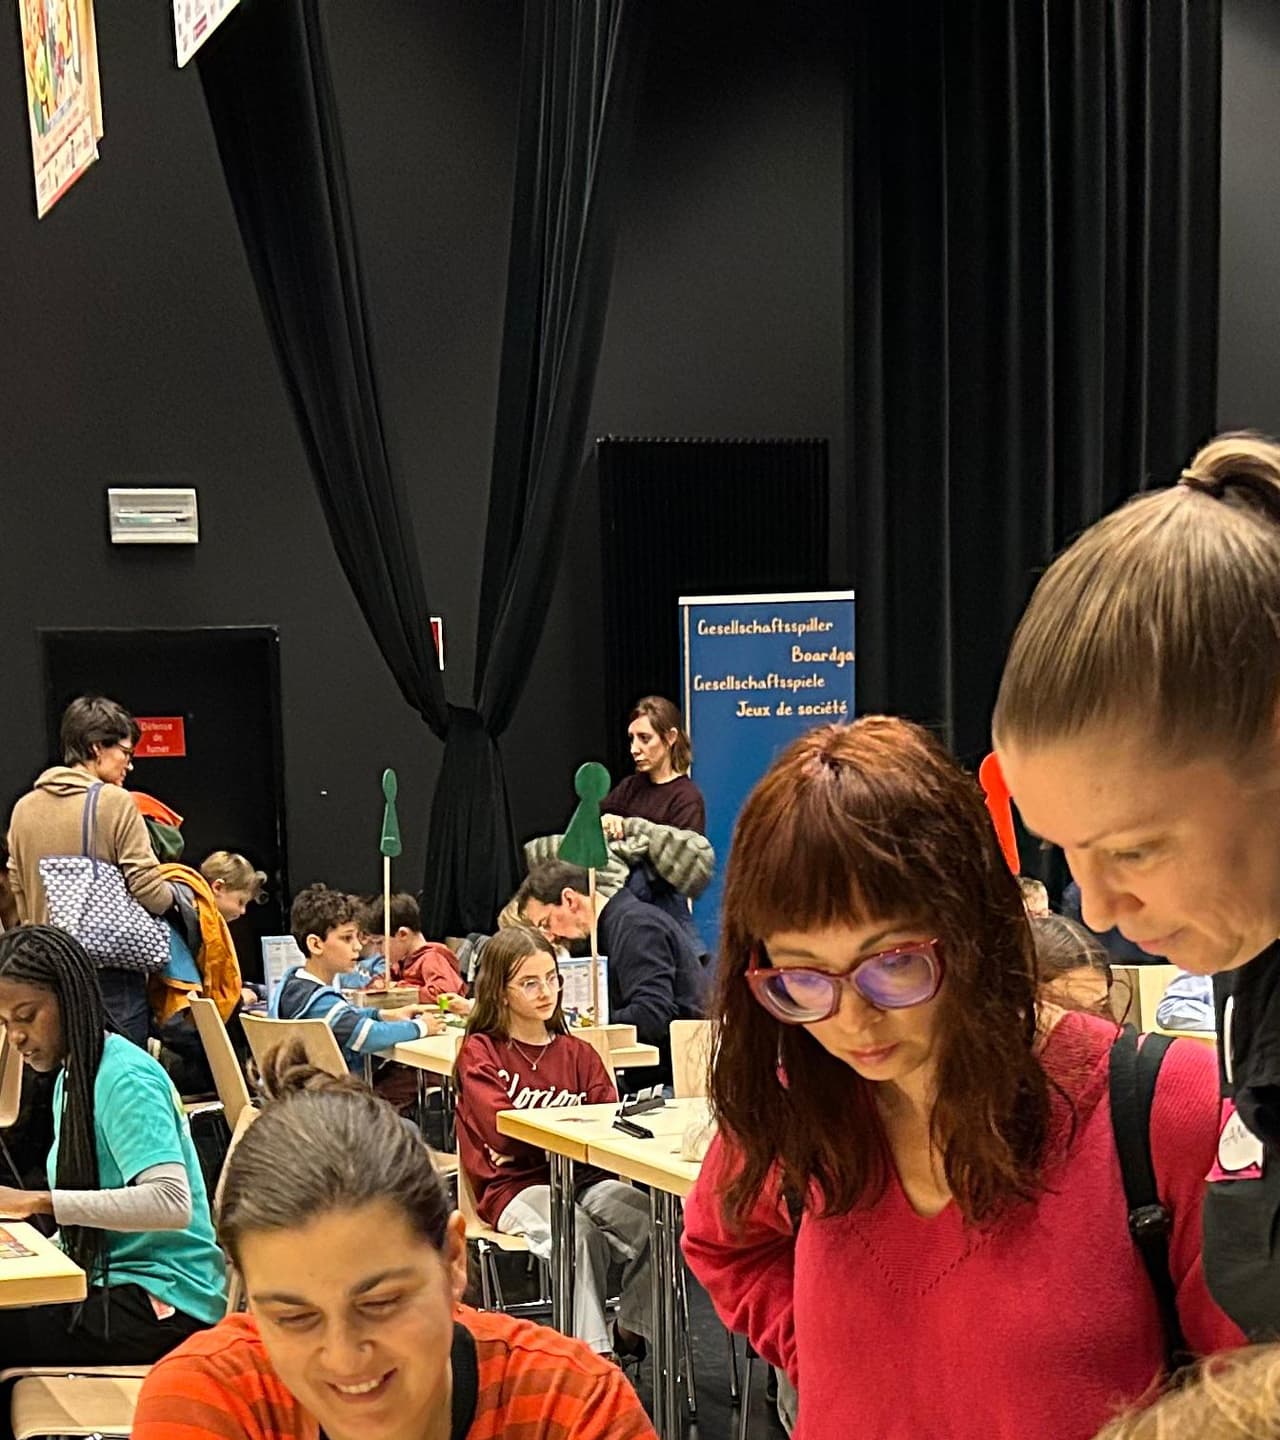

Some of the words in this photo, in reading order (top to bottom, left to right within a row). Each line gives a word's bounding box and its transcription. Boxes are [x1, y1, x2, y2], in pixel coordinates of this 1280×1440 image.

[697, 617, 833, 637] Gesellschaftsspiller
[791, 645, 854, 668] Boardga
[694, 673, 825, 693] Gesellschaftsspiele
[736, 700, 770, 717] Jeux
[776, 701, 793, 717] de
[798, 699, 848, 716] société
